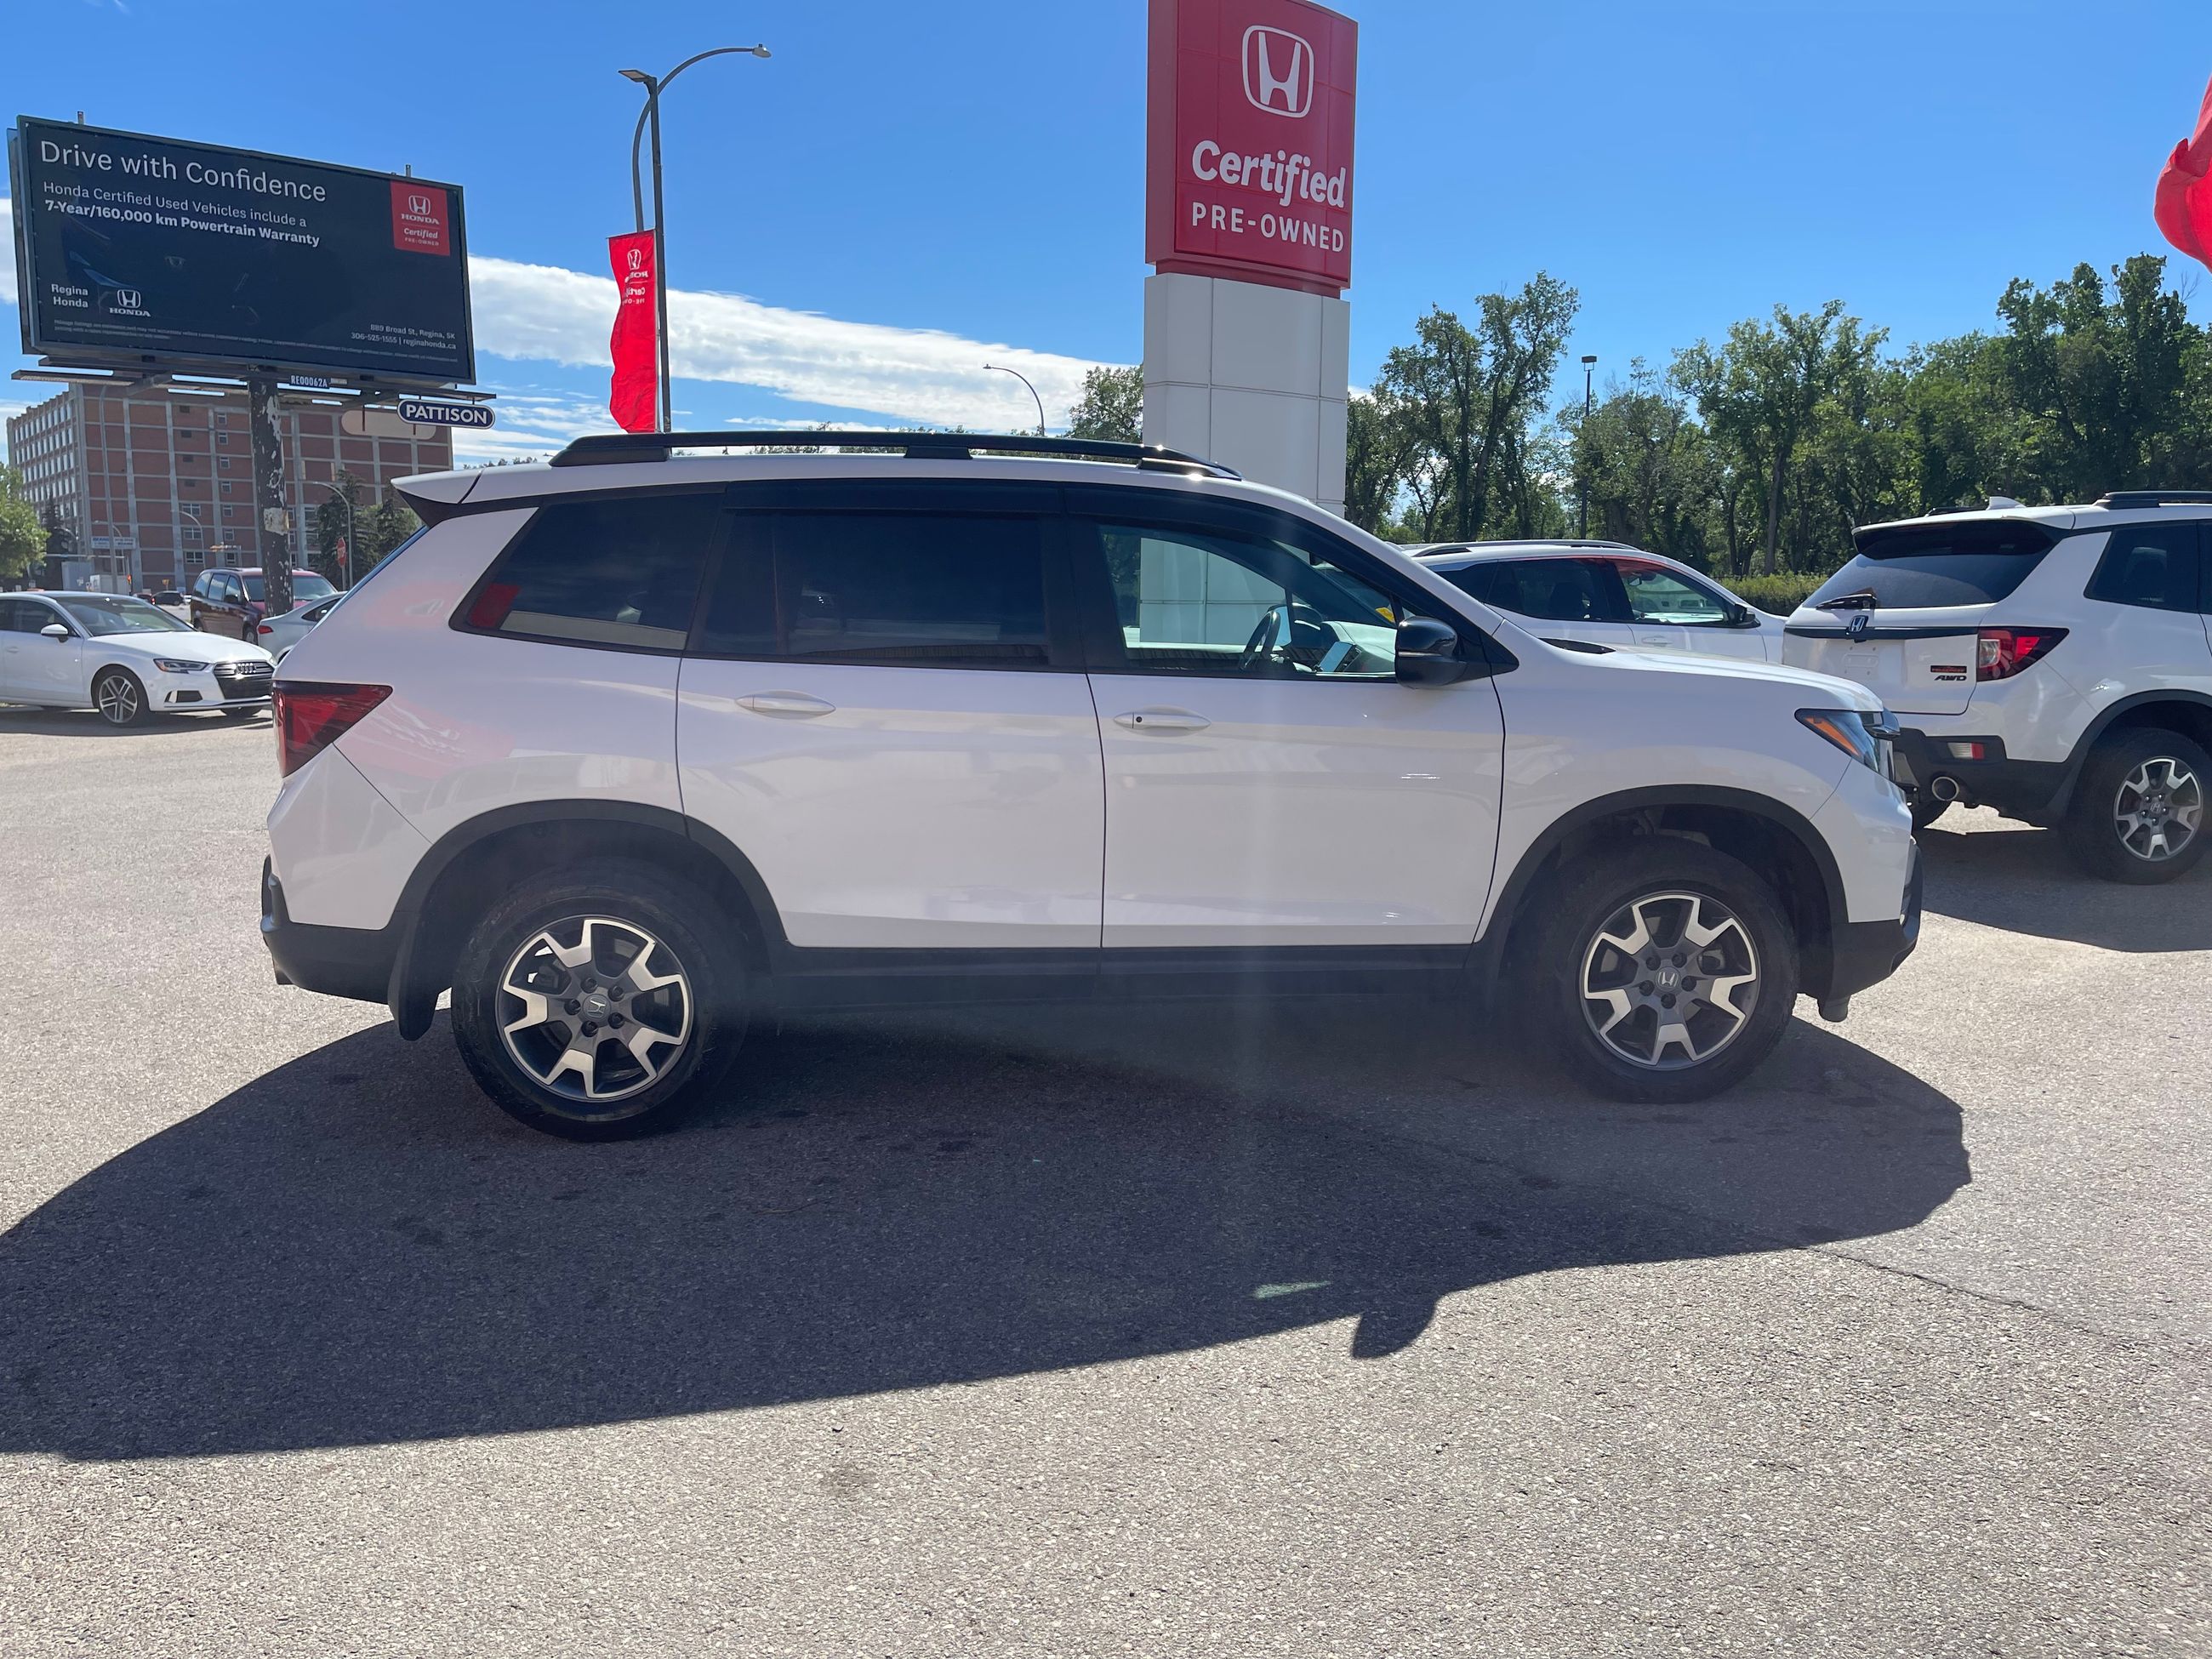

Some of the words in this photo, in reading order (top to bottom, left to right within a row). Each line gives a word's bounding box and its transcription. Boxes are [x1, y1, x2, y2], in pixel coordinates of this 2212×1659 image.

[41, 140, 112, 171] Drive
[120, 154, 177, 180] with
[185, 162, 326, 202] Confidence
[1192, 140, 1346, 208] Certified
[43, 180, 89, 198] Honda
[94, 187, 151, 206] Certified
[156, 196, 188, 211] Used
[192, 201, 247, 219] Vehicles
[250, 208, 296, 225] include
[299, 218, 307, 227] a
[45, 199, 152, 223] 7-Year/160,000
[156, 213, 177, 226] km
[180, 217, 256, 237] Powertrain
[259, 226, 320, 248] Warranty
[401, 213, 440, 225] HONDA
[1192, 202, 1344, 252] PRE-OWNED
[404, 227, 438, 239] Certified
[51, 283, 88, 296] Regina
[53, 296, 88, 308] Honda
[109, 307, 151, 317] HONDA
[406, 405, 487, 424] PATTISON
